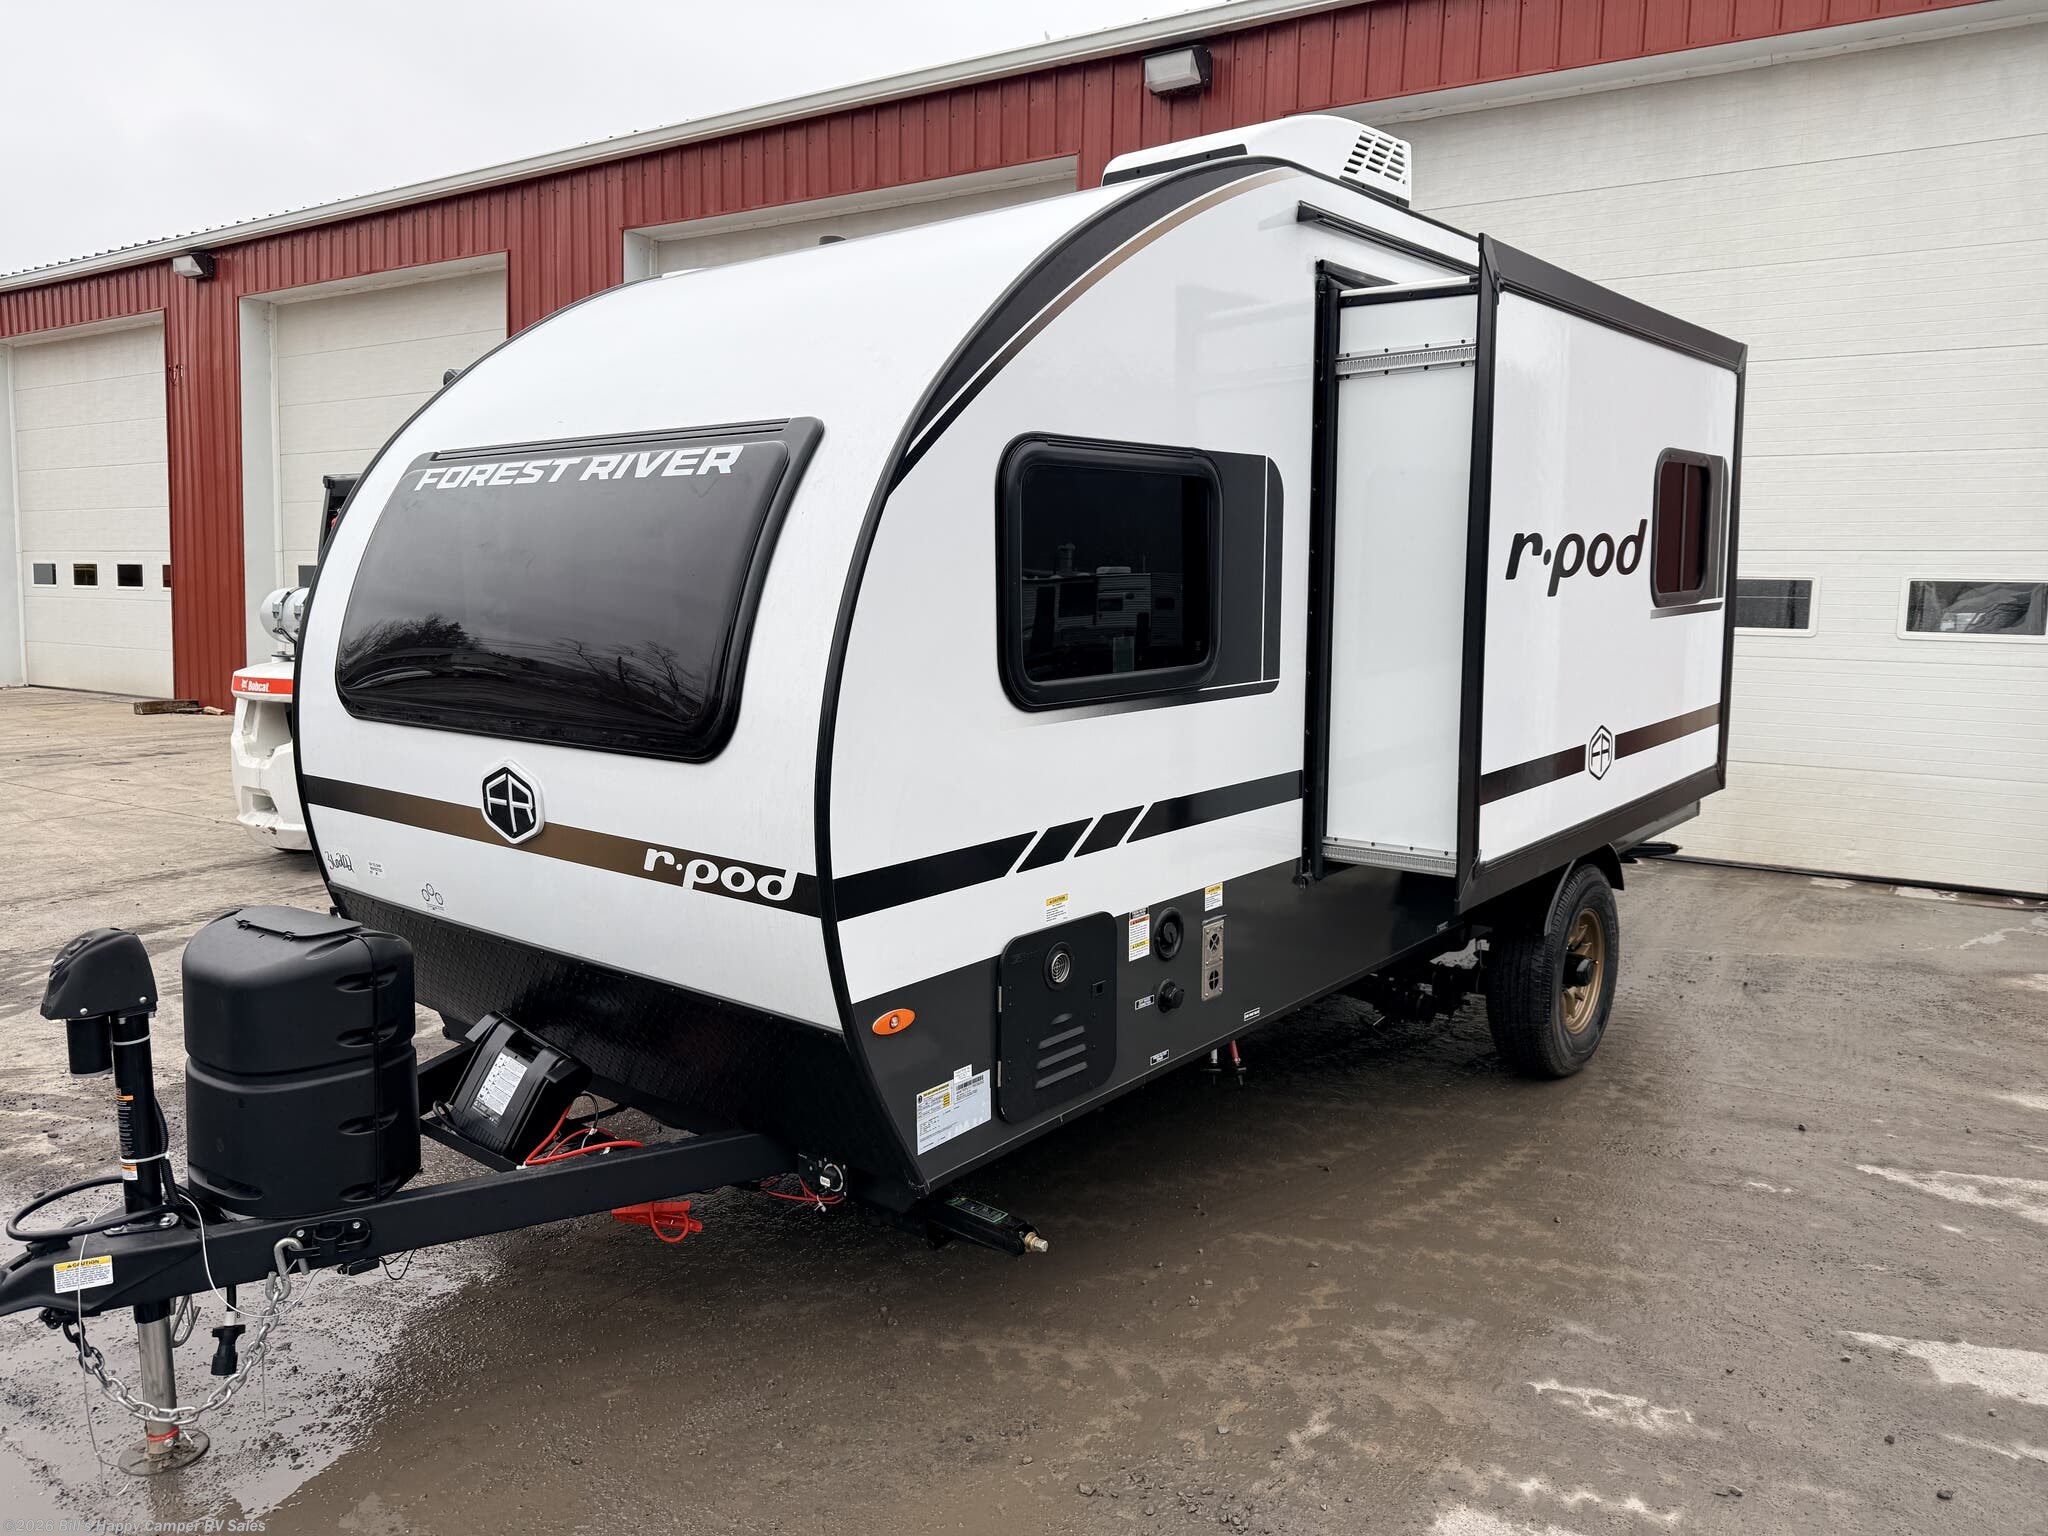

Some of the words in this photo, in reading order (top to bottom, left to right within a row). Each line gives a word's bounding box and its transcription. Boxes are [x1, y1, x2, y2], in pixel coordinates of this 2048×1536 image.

[414, 457, 588, 491] FOREST
[579, 446, 744, 481] RIVER
[247, 680, 270, 692] Bobcat
